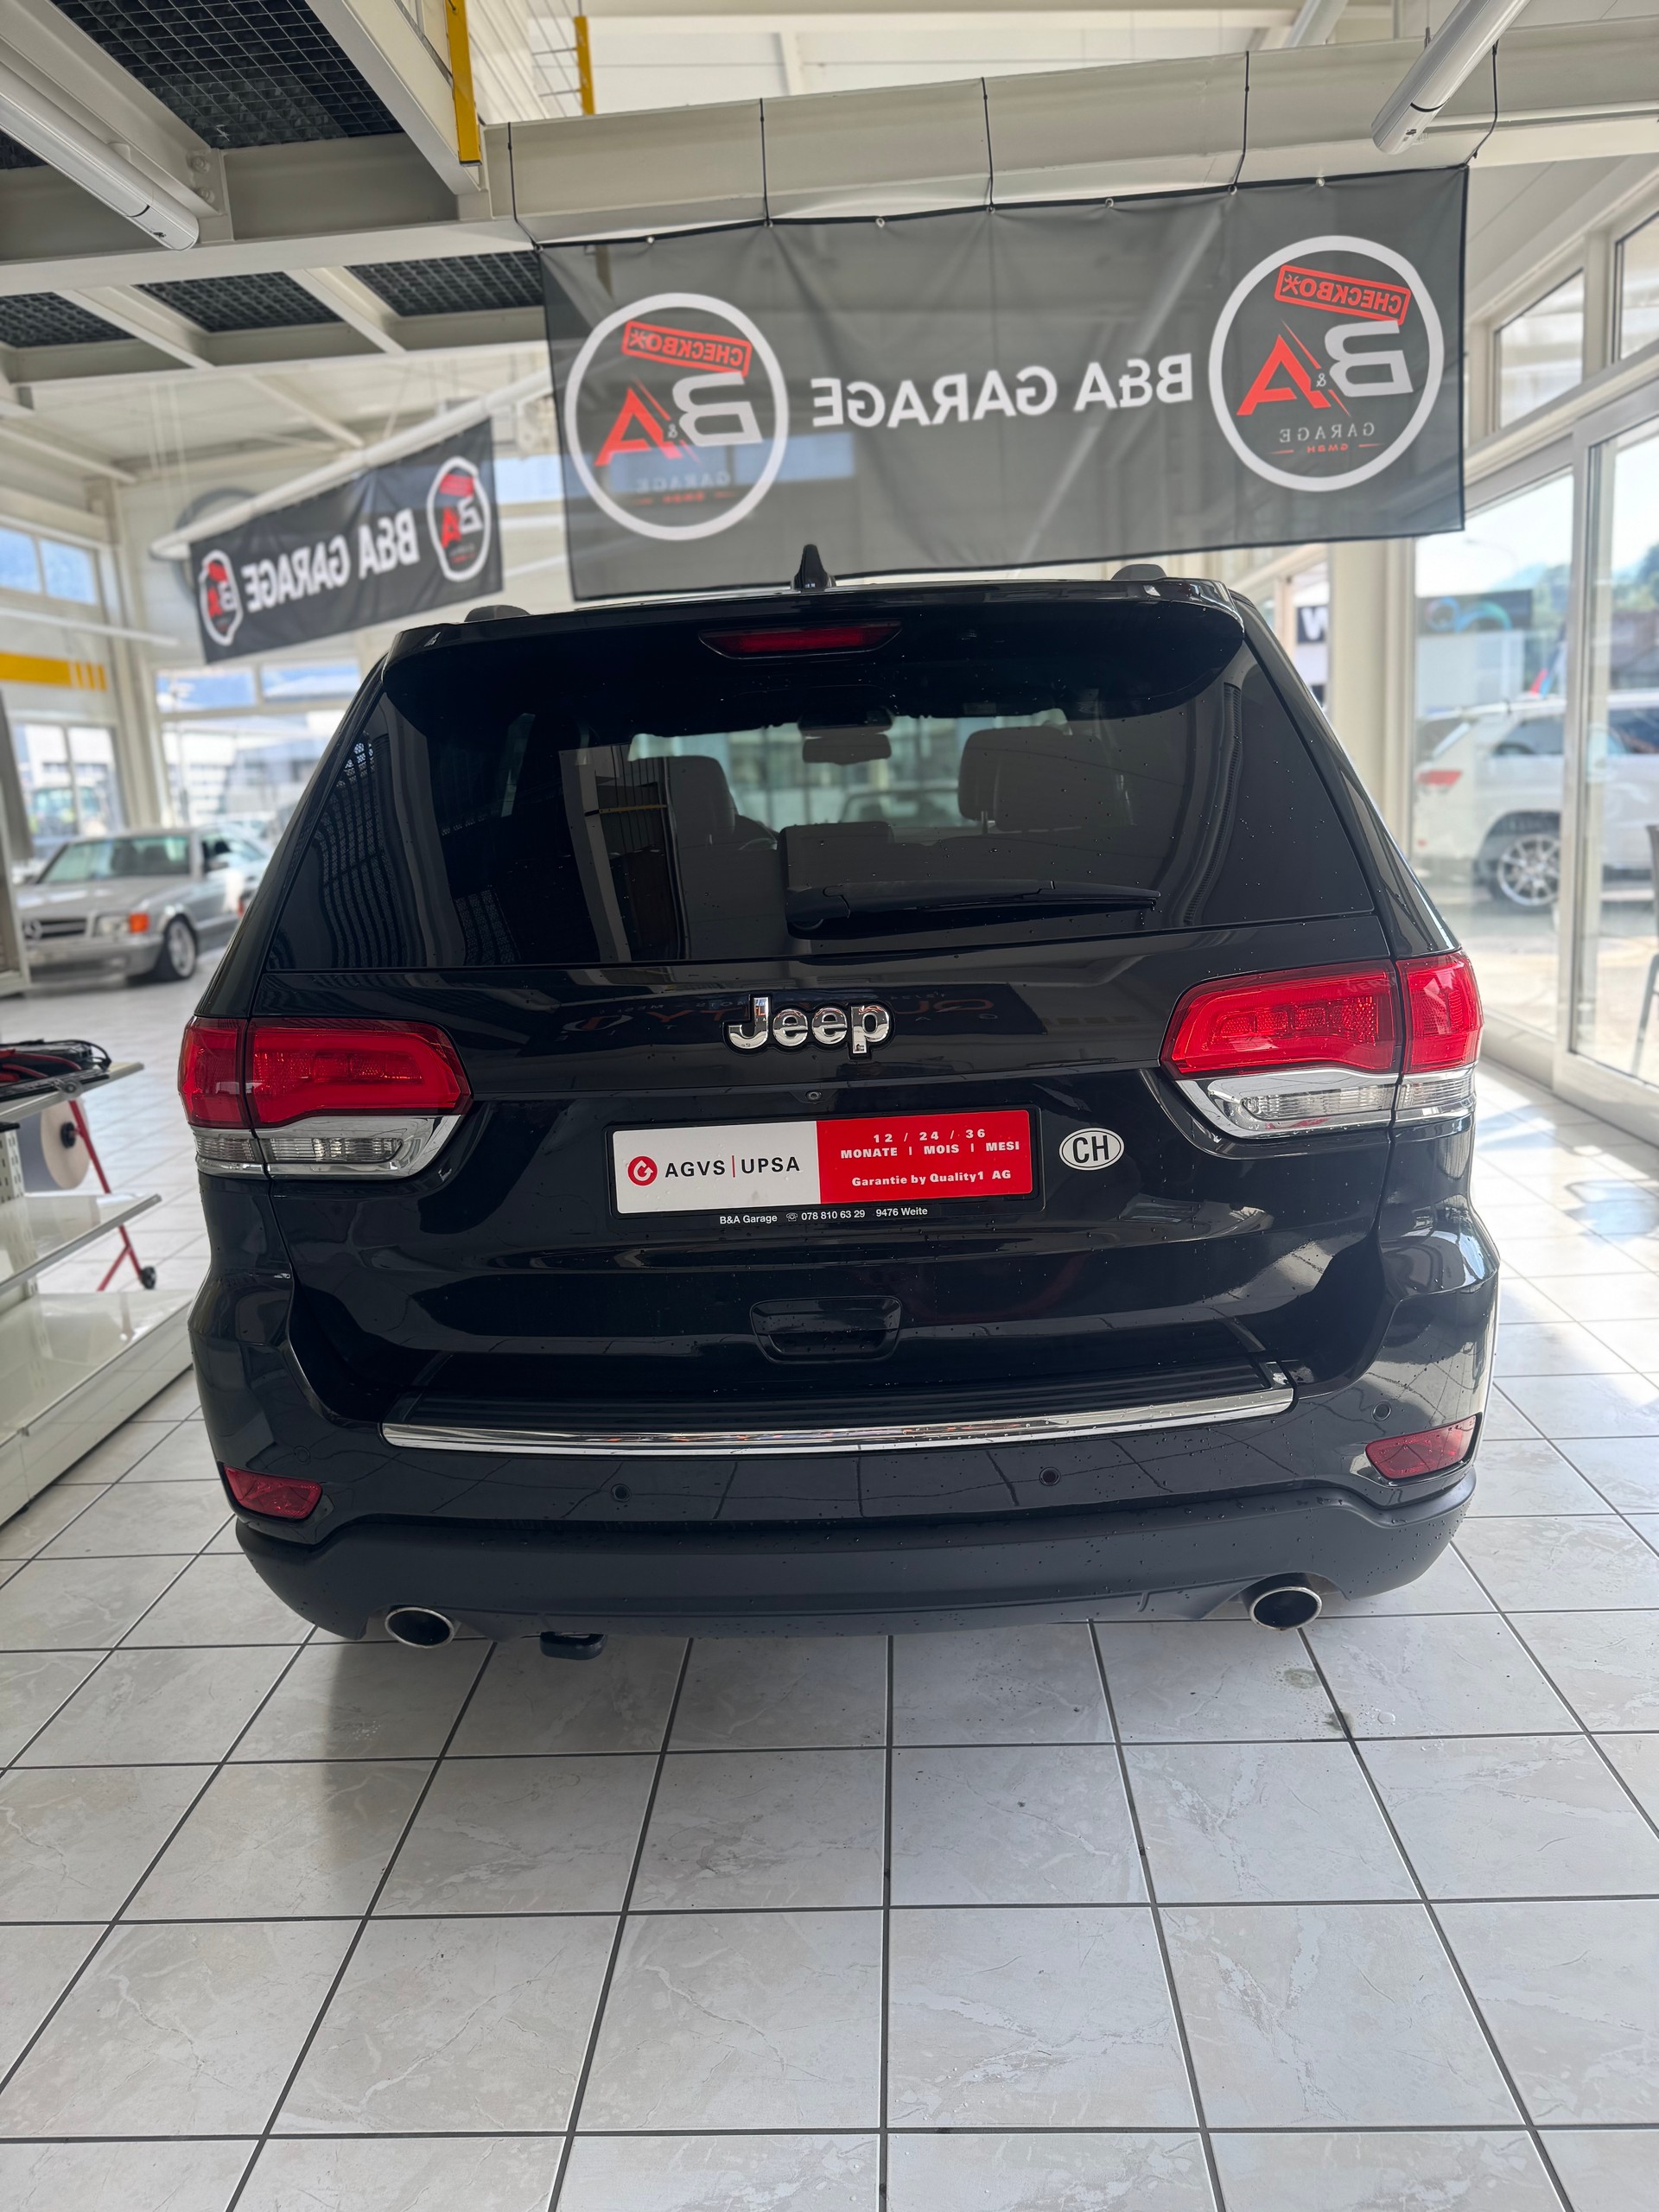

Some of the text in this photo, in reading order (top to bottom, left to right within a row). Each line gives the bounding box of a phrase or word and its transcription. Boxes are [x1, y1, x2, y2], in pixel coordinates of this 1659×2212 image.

[728, 996, 891, 1055] Jeep
[873, 1134, 893, 1143] 12
[918, 1131, 940, 1141] 24
[965, 1128, 986, 1139] 36
[840, 1147, 898, 1159] MONATE
[924, 1144, 960, 1155] MOIS
[985, 1141, 1020, 1152] MESI
[1072, 1135, 1109, 1164] CH
[664, 1156, 800, 1178] AGVS UPSA
[851, 1170, 1012, 1186] Garantie by Quality1 AG
[719, 1207, 928, 1224] B&A Garage 078 810 63 29 9476 Weite
